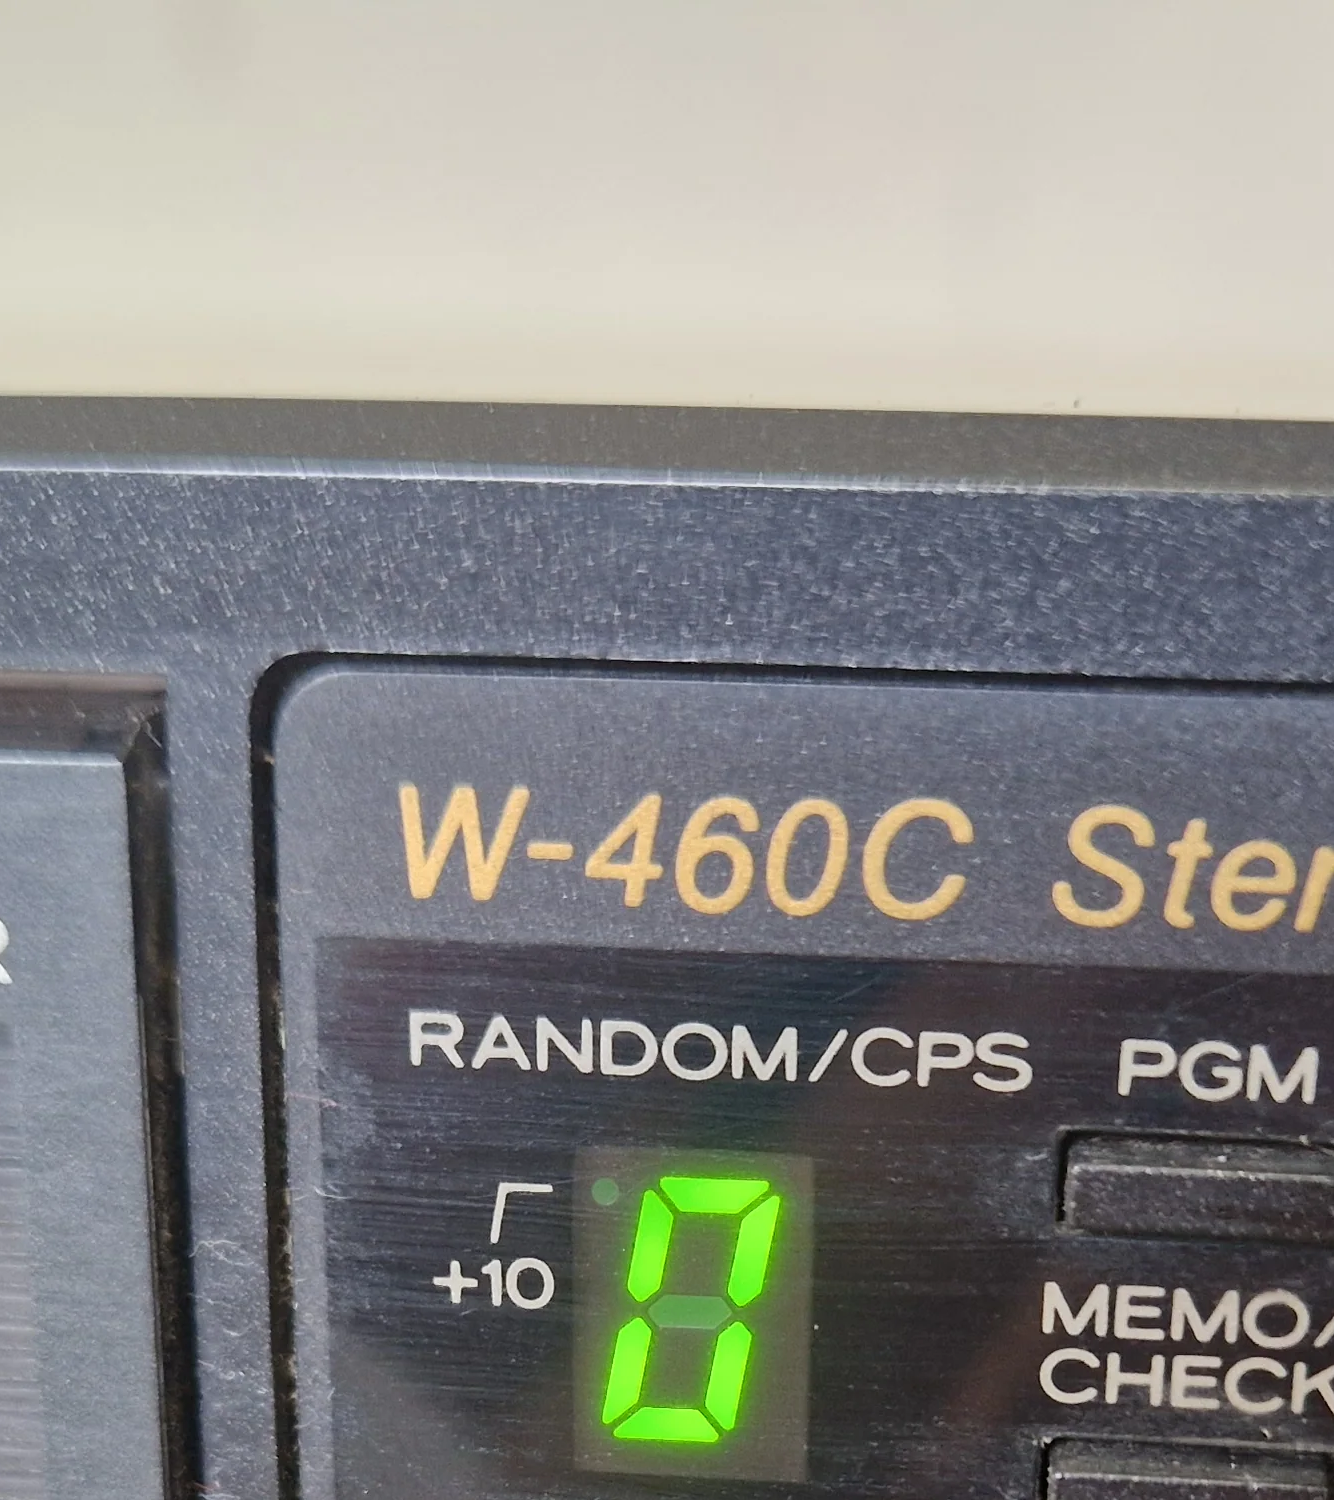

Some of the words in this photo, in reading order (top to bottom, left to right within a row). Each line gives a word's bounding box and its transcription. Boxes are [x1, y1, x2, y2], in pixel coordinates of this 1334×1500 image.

[399, 783, 975, 920] W-460C
[407, 1009, 1034, 1093] RANDOM/CPS
[1117, 1038, 1321, 1105] PGM
[432, 1257, 555, 1311] +10
